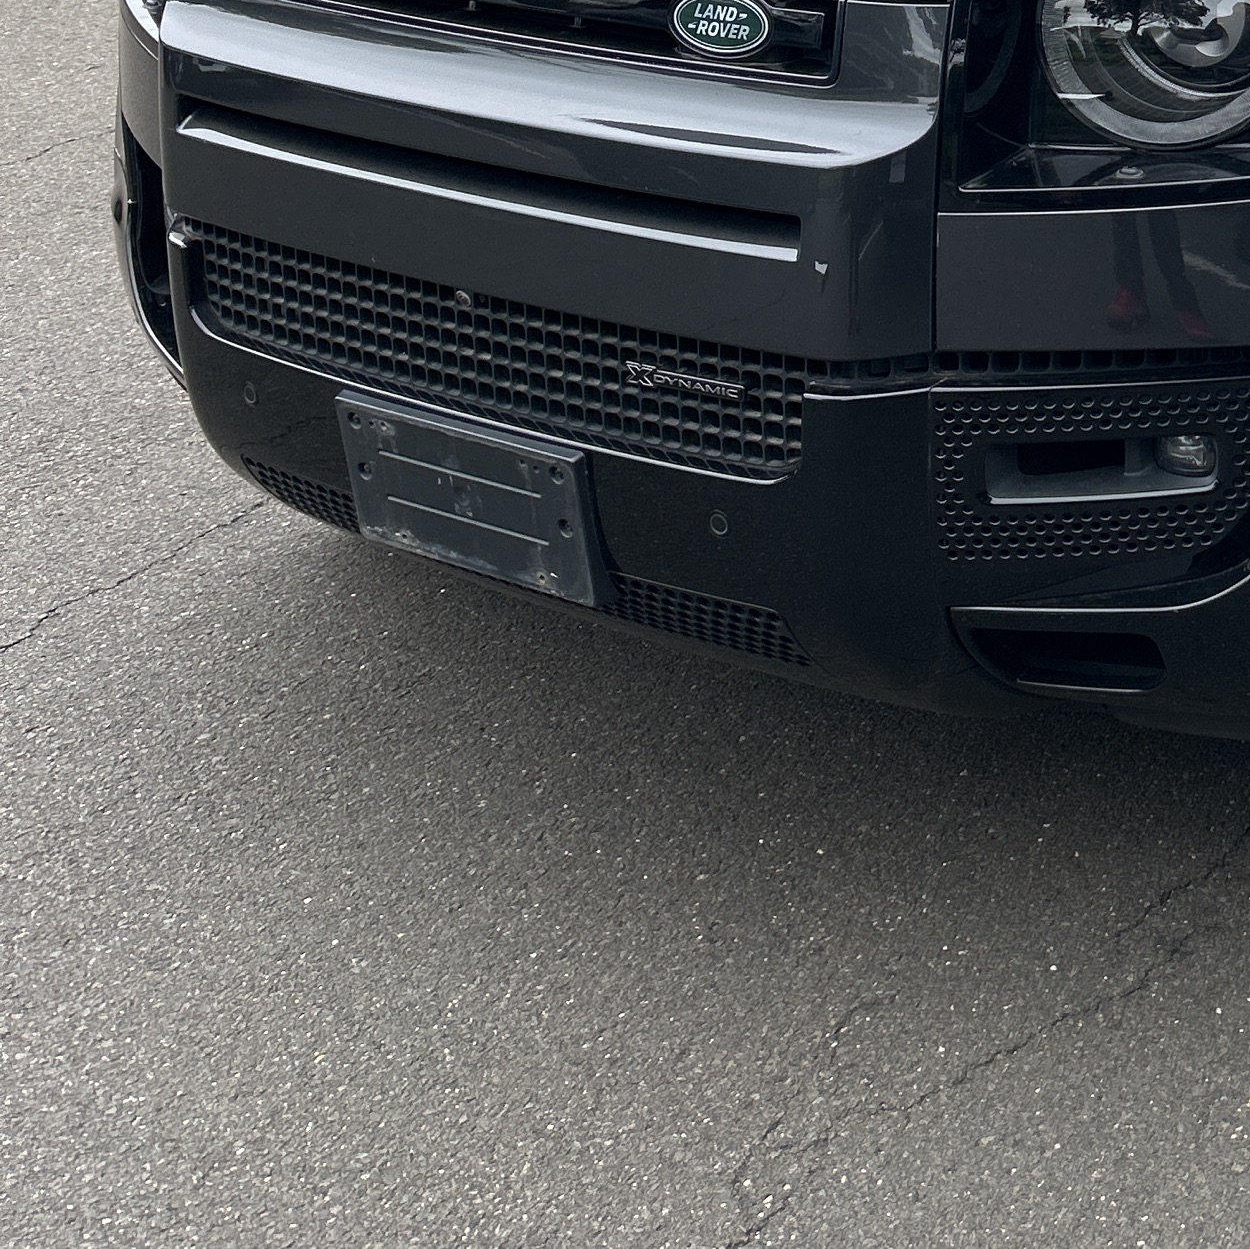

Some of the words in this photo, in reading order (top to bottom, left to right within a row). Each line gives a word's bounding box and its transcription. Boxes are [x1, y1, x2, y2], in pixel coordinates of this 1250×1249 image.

[694, 2, 738, 22] LAND
[696, 19, 750, 41] ROVER
[653, 373, 739, 399] DYNAMIC
